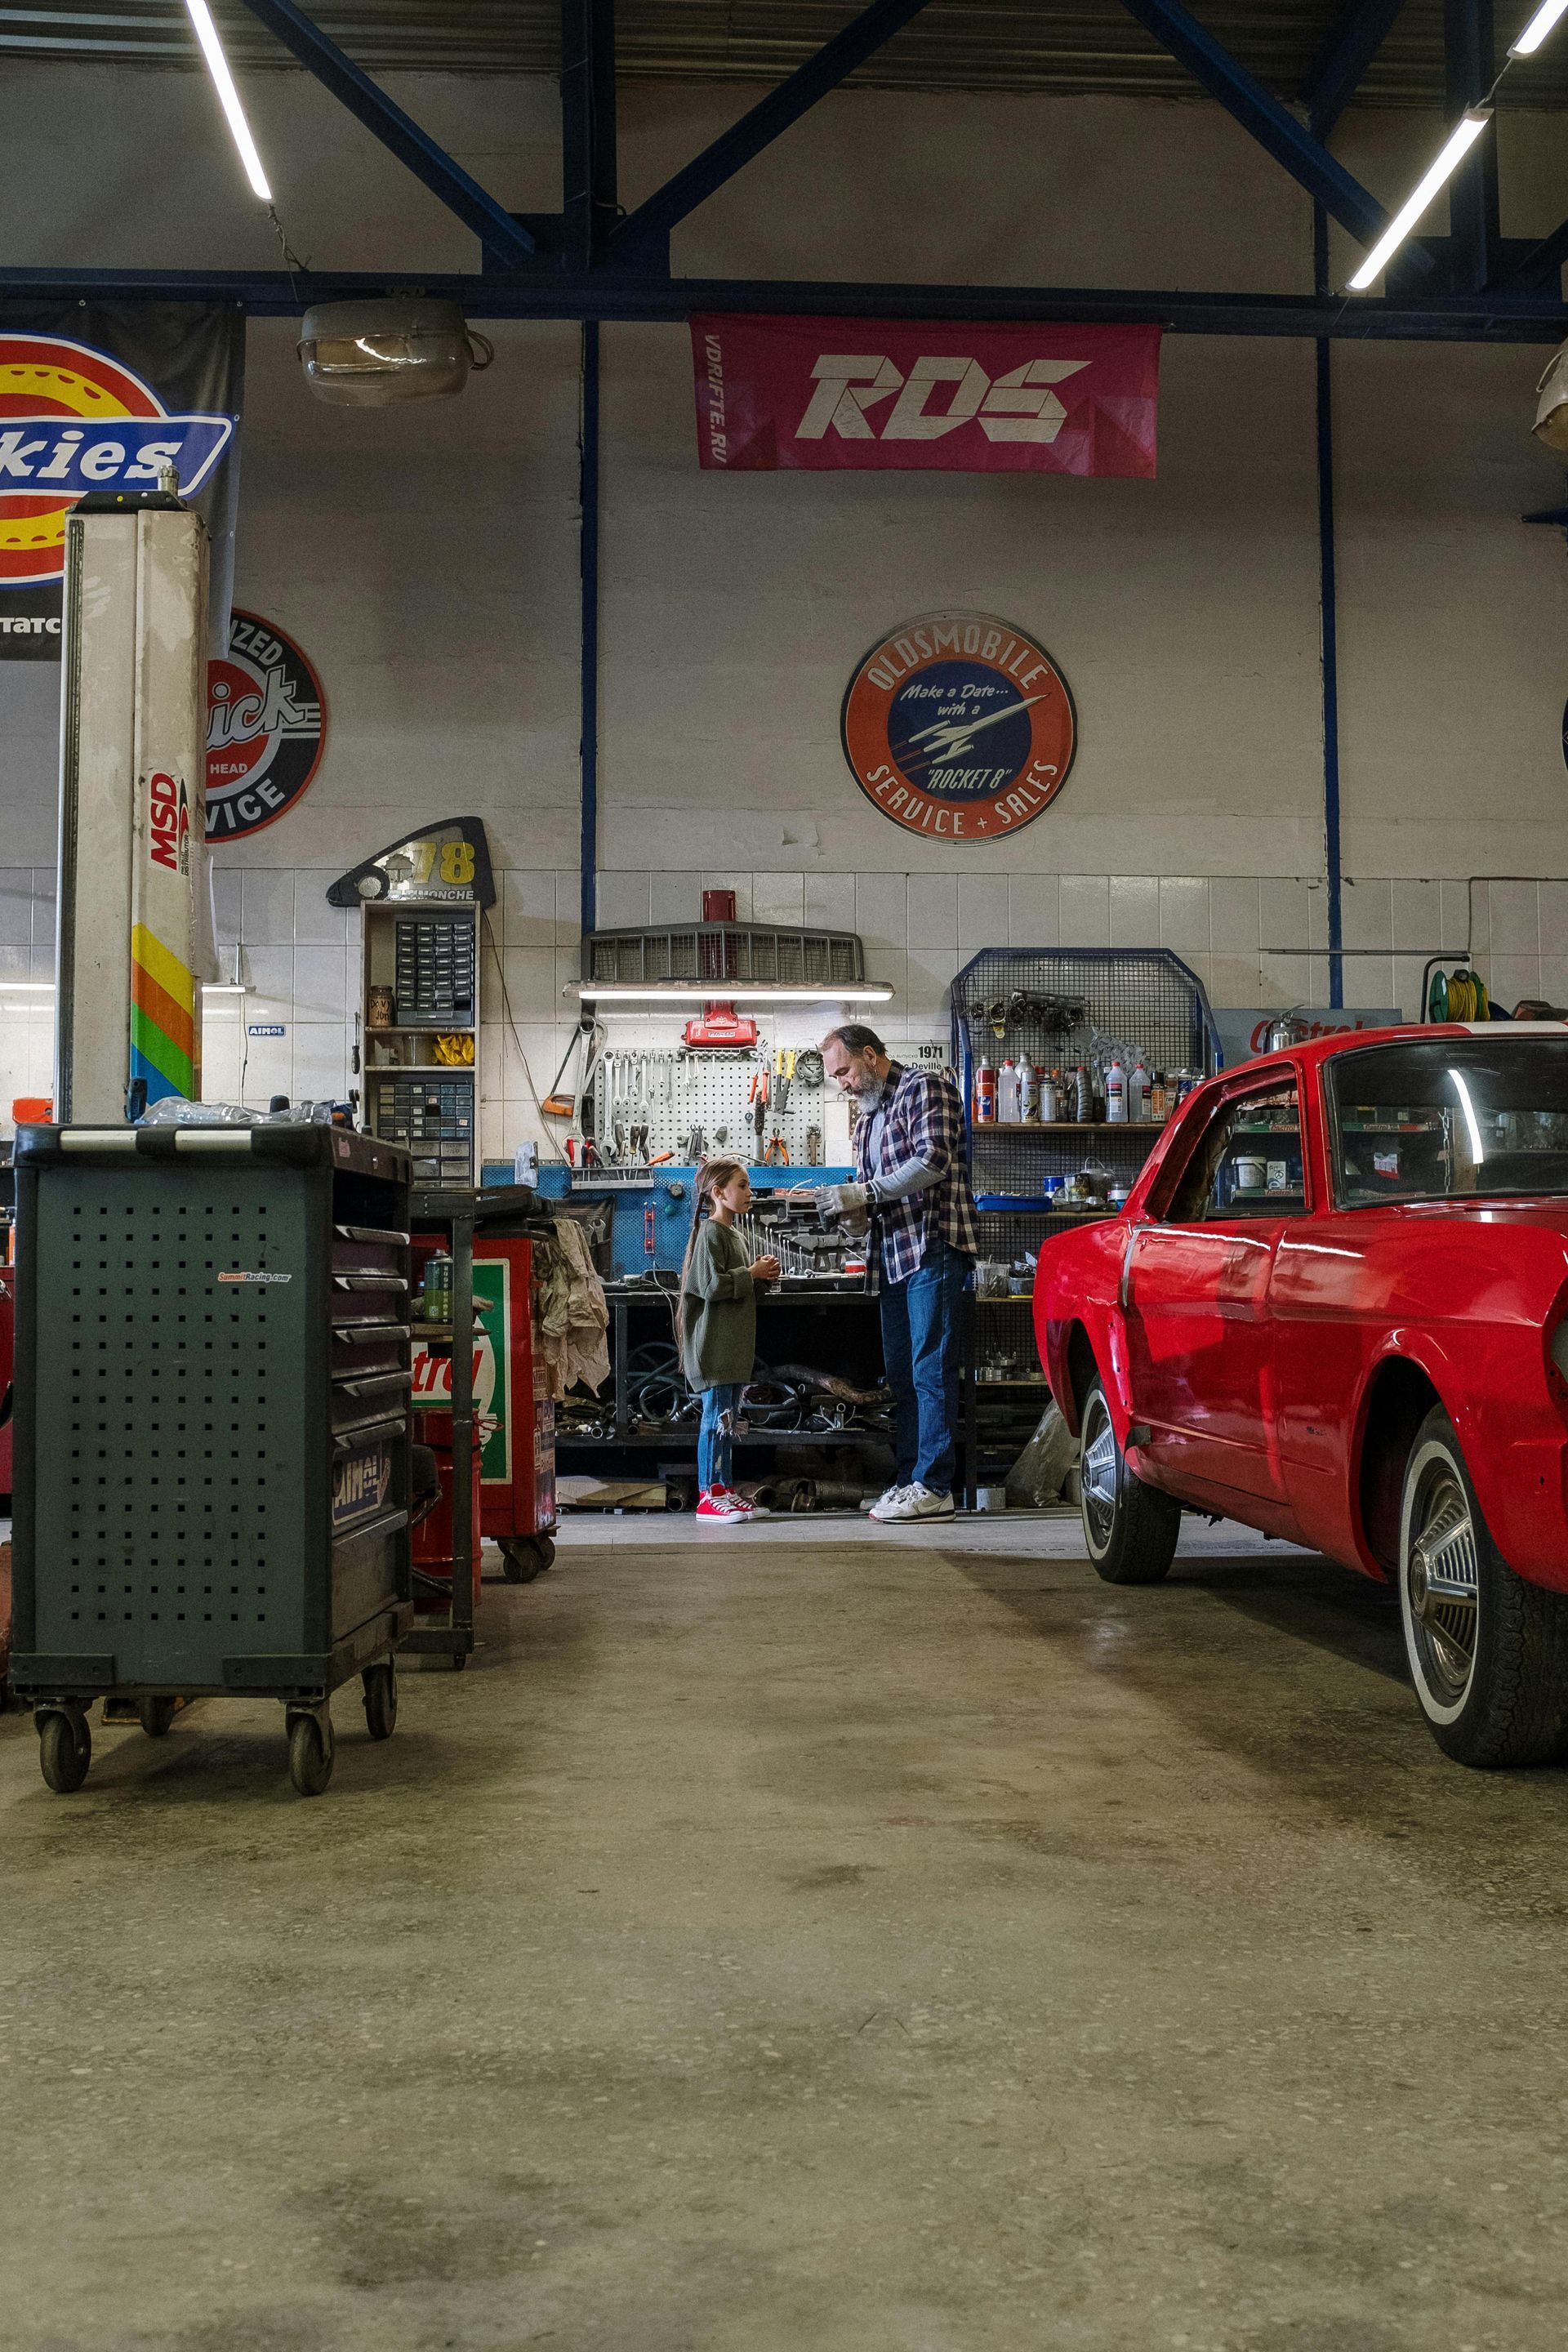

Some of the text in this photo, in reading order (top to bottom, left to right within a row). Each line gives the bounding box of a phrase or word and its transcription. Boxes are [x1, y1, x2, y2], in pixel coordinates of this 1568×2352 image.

[704, 334, 728, 463] VDRIFTE.RU
[795, 354, 1094, 443] RDS
[867, 624, 1049, 691] OLDSMOBILE
[900, 684, 942, 701] Make
[947, 688, 956, 697] a
[938, 702, 980, 716] with a
[210, 764, 248, 774] HEAD
[866, 764, 965, 835] SERVICE
[994, 760, 1058, 824] SALES
[151, 773, 177, 871] MSD
[409, 841, 475, 884] 78
[911, 1062, 942, 1070] Deville
[918, 1045, 943, 1058] 1971
[219, 1272, 289, 1281] SummitRacing.com
